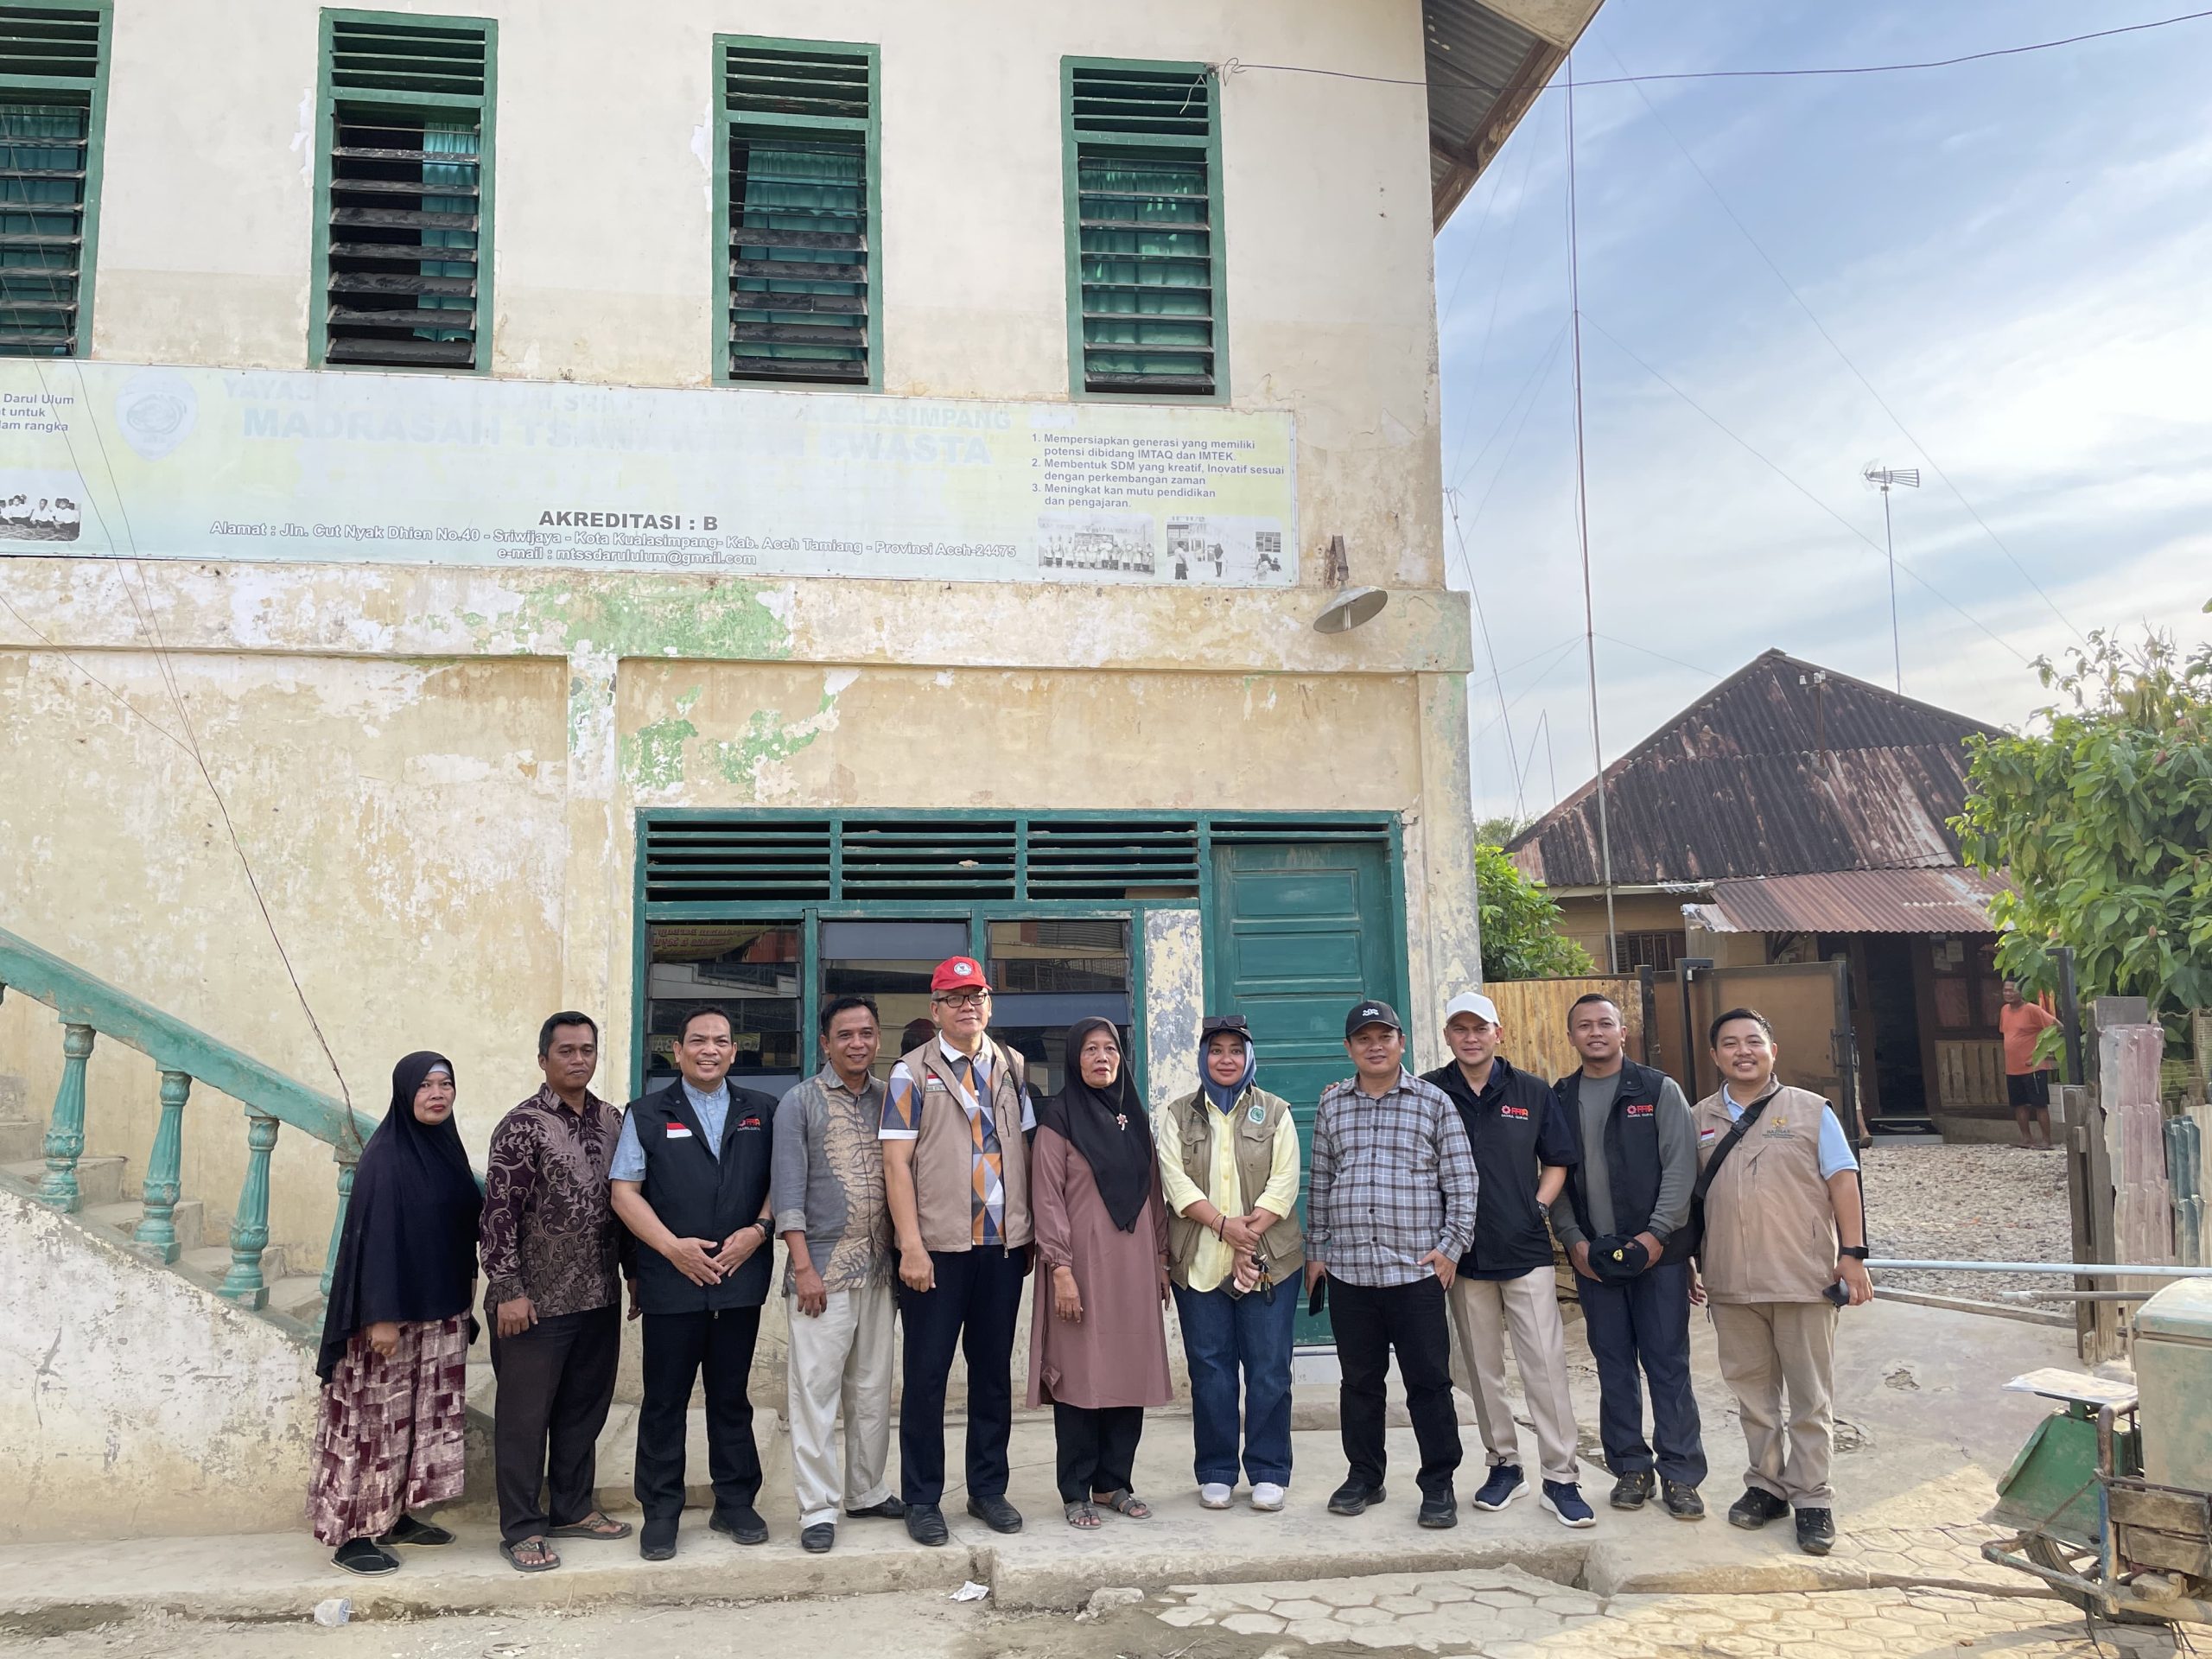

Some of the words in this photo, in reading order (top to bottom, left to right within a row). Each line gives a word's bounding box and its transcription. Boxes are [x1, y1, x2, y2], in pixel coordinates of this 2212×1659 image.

[3, 393, 37, 404] Darul
[41, 394, 74, 405] Ulum
[10, 407, 46, 417] untuk
[24, 422, 68, 434] rangka
[244, 406, 499, 446] MADRASAH
[1032, 433, 1041, 443] 1.
[1044, 434, 1130, 448] Mempersiapkan
[1133, 436, 1179, 449] generasi
[1181, 440, 1209, 450] yang
[1211, 438, 1255, 449] memiliki
[1044, 446, 1084, 459] potensi
[1088, 447, 1135, 461] dibidang
[1137, 449, 1173, 461] IMTAQ
[1176, 450, 1196, 461] dan
[1198, 450, 1236, 461] IMTEK.
[1032, 458, 1041, 467] 2.
[1044, 459, 1107, 470] Membentuk
[1110, 460, 1135, 471] SDM
[1138, 462, 1165, 474] yang
[1167, 461, 1203, 474] kreatif,
[1207, 462, 1247, 474] Inovatif
[1249, 464, 1285, 475] sesuai
[1044, 471, 1085, 484] dengan
[1088, 472, 1167, 486] perkembangan
[1171, 476, 1206, 485] zaman
[1032, 484, 1041, 493] 3.
[1044, 484, 1101, 498] Meningkat
[1104, 485, 1123, 495] kan
[1127, 486, 1154, 497] mutu
[1157, 486, 1216, 499] pendidikan
[1045, 495, 1065, 506] dan
[1068, 498, 1131, 510] pengajaran.
[538, 510, 683, 531] AKREDITASI
[689, 518, 696, 531] :
[702, 516, 718, 531] B
[210, 520, 266, 537] Alamat
[280, 523, 309, 538] Jln.
[313, 524, 341, 539] Cut
[344, 524, 384, 542] Nyak
[387, 524, 433, 541] Dhien
[435, 527, 480, 542] No.40
[493, 529, 562, 547] Sriwijaya
[575, 531, 610, 547] Kota
[726, 534, 759, 550] Kab.
[761, 536, 799, 551] Aceh
[802, 537, 863, 556] Tamiang
[874, 540, 932, 556] Provinsi
[936, 542, 1017, 558] Aceh-24475
[498, 546, 543, 560] e-mail
[556, 549, 757, 567] mtssdarululum@gmail.com
